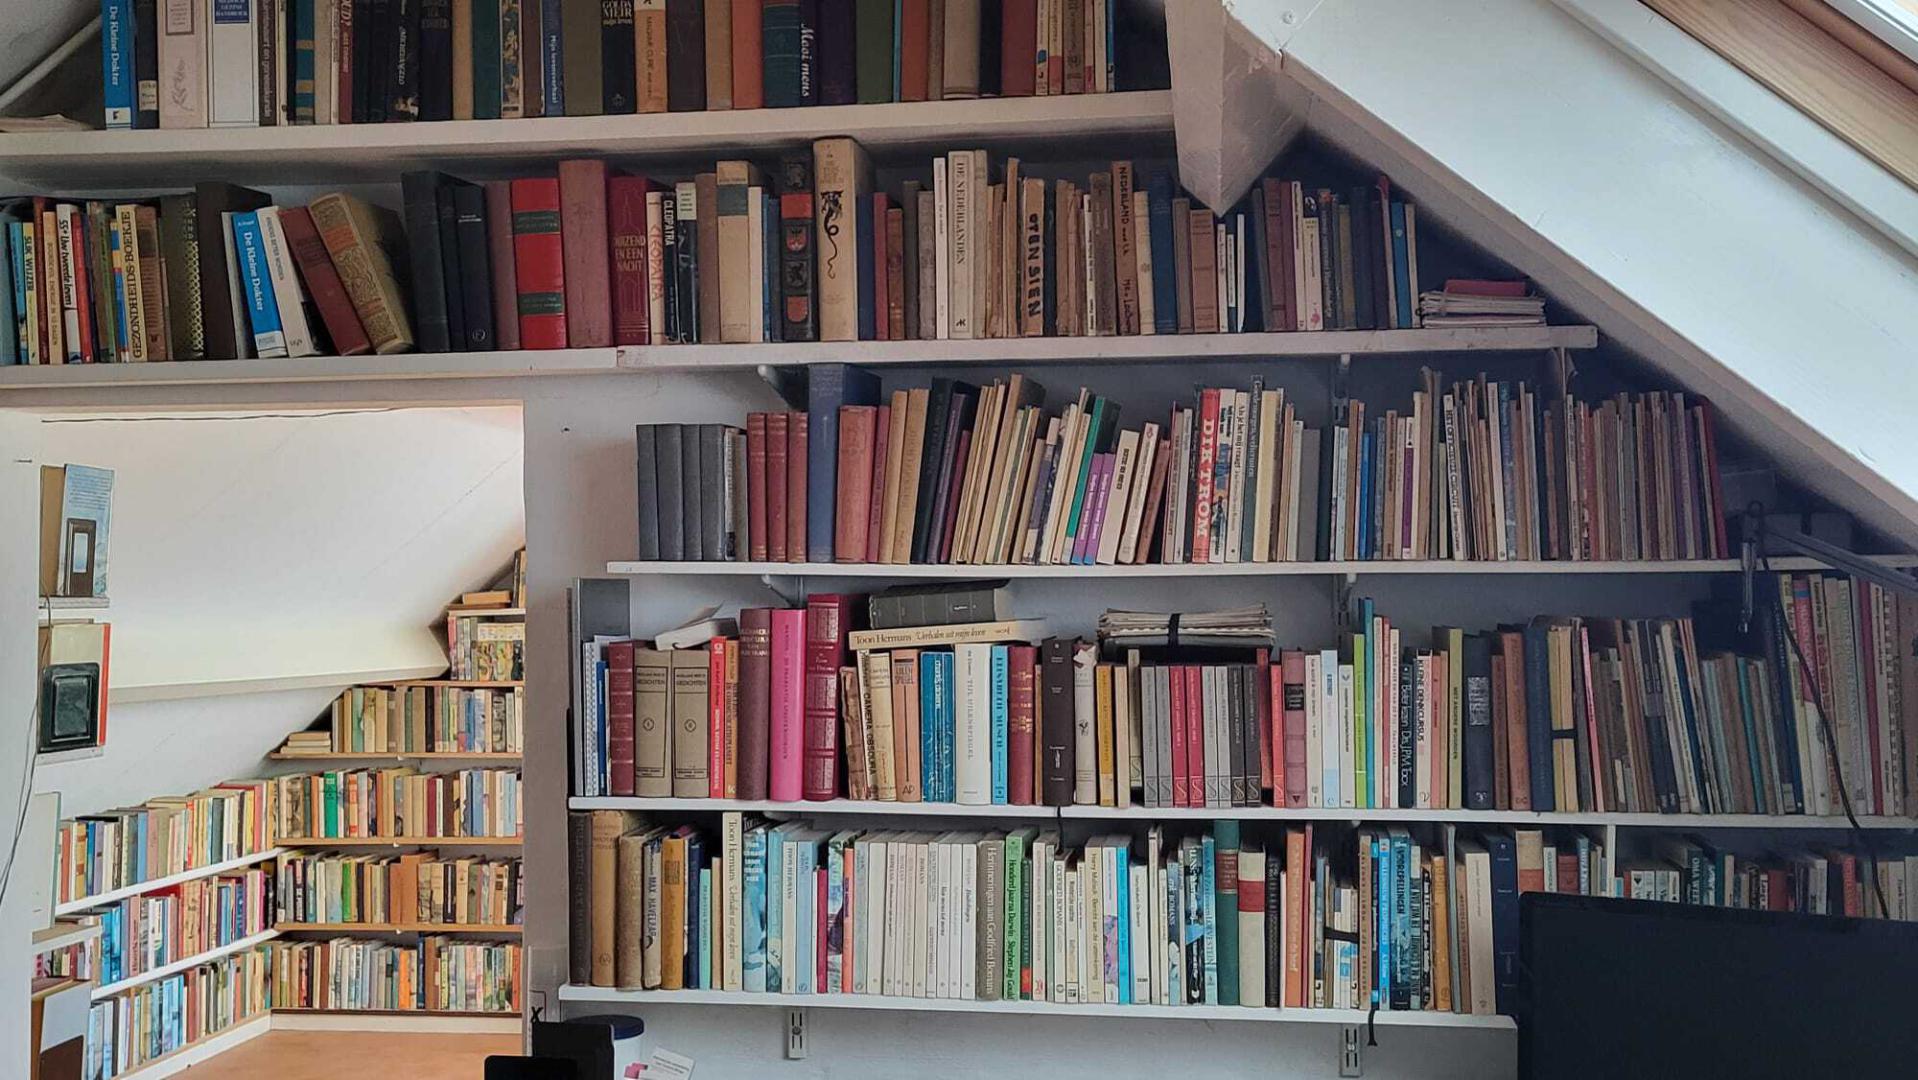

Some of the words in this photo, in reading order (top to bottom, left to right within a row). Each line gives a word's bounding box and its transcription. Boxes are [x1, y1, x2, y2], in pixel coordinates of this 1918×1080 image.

[109, 6, 119, 20] De
[263, 0, 272, 47] uimtevaart
[603, 8, 632, 17] MEIR
[109, 21, 119, 51] Kleine
[549, 35, 557, 51] Mijn
[646, 16, 654, 48] MADAME
[800, 23, 815, 60] Mooi
[110, 53, 120, 85] Dokter
[263, 49, 271, 59] en
[398, 26, 408, 85] MICHELANGELO
[261, 61, 273, 117] geneeskunde
[549, 53, 558, 103] levensverhaal
[800, 63, 811, 96] mens
[956, 163, 965, 178] DE
[1118, 167, 1130, 224] NEDERLAND
[663, 200, 675, 246] CLEOPATRA
[956, 182, 966, 265] NEDERLANDEN
[60, 236, 69, 250] Uw
[242, 232, 254, 246] De
[616, 248, 626, 259] EN
[627, 248, 644, 259] EEN
[25, 259, 34, 291] WIJZER
[62, 252, 72, 282] tweede
[246, 247, 258, 277] Kleine
[617, 260, 643, 272] NACHT
[649, 224, 664, 302] CLEOPATRA
[64, 284, 73, 305] leven
[252, 278, 264, 311] Dokter
[1027, 266, 1041, 318] SIEN
[1201, 419, 1215, 464] DIK
[1235, 435, 1244, 446] mij
[1237, 424, 1245, 434] het
[1233, 447, 1242, 469] vraagt
[1197, 468, 1212, 538] TROM
[854, 635, 876, 645] Toon
[876, 633, 912, 643] Hermans
[995, 657, 1004, 709] ELISABETH
[1417, 660, 1425, 686] KLEINE
[1400, 684, 1411, 704] Beter
[863, 692, 873, 730] CAMERA
[1401, 706, 1412, 727] lezen
[1417, 688, 1425, 742] DENKCURSUS
[966, 699, 974, 761] UILENSPIEGEL
[995, 714, 1004, 748] MUSCH
[866, 734, 877, 776] OBSCURA
[728, 819, 737, 841] Toon
[728, 843, 737, 881] Hermans
[985, 847, 997, 906] Herinneringen
[1007, 860, 1016, 888] Honderd
[1691, 857, 1700, 878] OMA
[648, 877, 656, 893] MAX
[1006, 888, 1015, 903] jaar
[1396, 849, 1406, 914] VOORSPELLINGEN
[647, 898, 657, 936] HAVELAAR
[986, 906, 994, 922] aan
[1007, 912, 1016, 936] Darwin
[1168, 895, 1176, 925] BOMANS
[986, 922, 996, 960] Godfried
[1006, 940, 1015, 968] Stephen
[985, 961, 994, 994] Bomans
[1006, 968, 1015, 979] Jay
